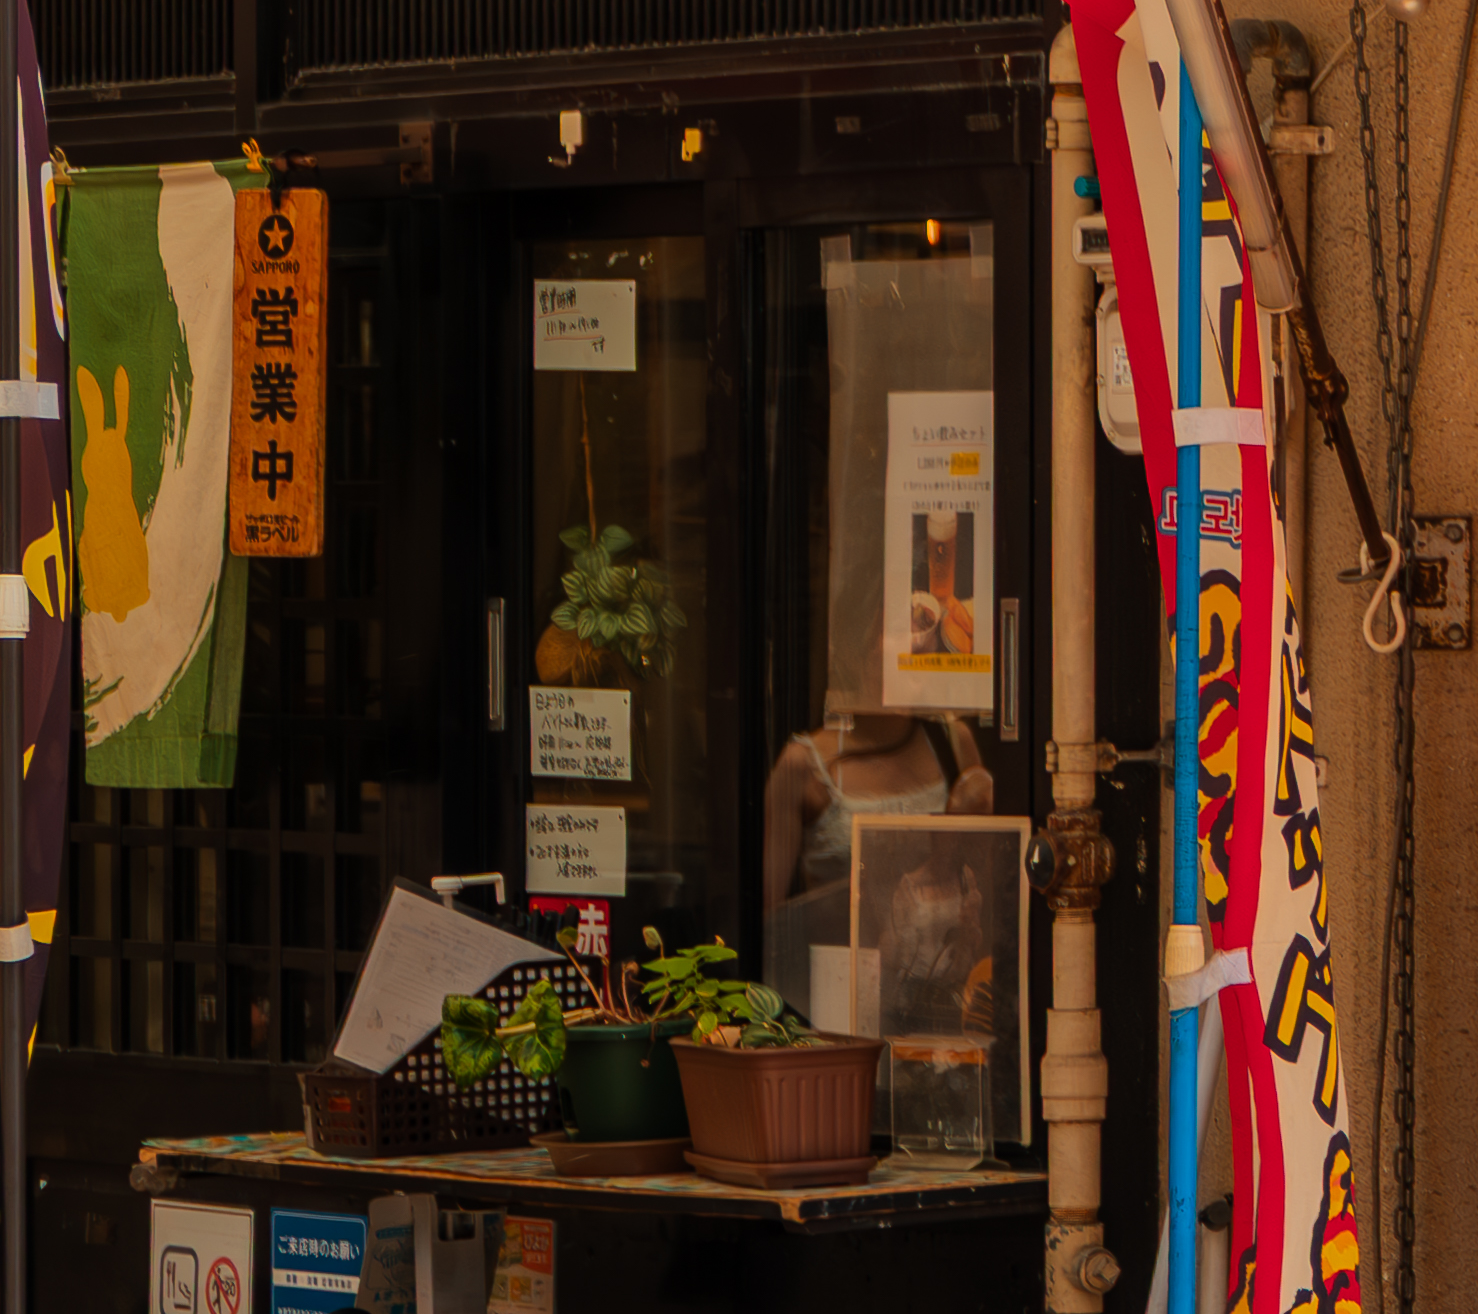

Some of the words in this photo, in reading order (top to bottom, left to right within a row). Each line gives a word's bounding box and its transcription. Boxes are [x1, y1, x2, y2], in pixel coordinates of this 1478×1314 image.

[251, 259, 300, 274] SAPPORO
[250, 287, 299, 502] 営業中
[245, 524, 300, 543] 黒ラベル
